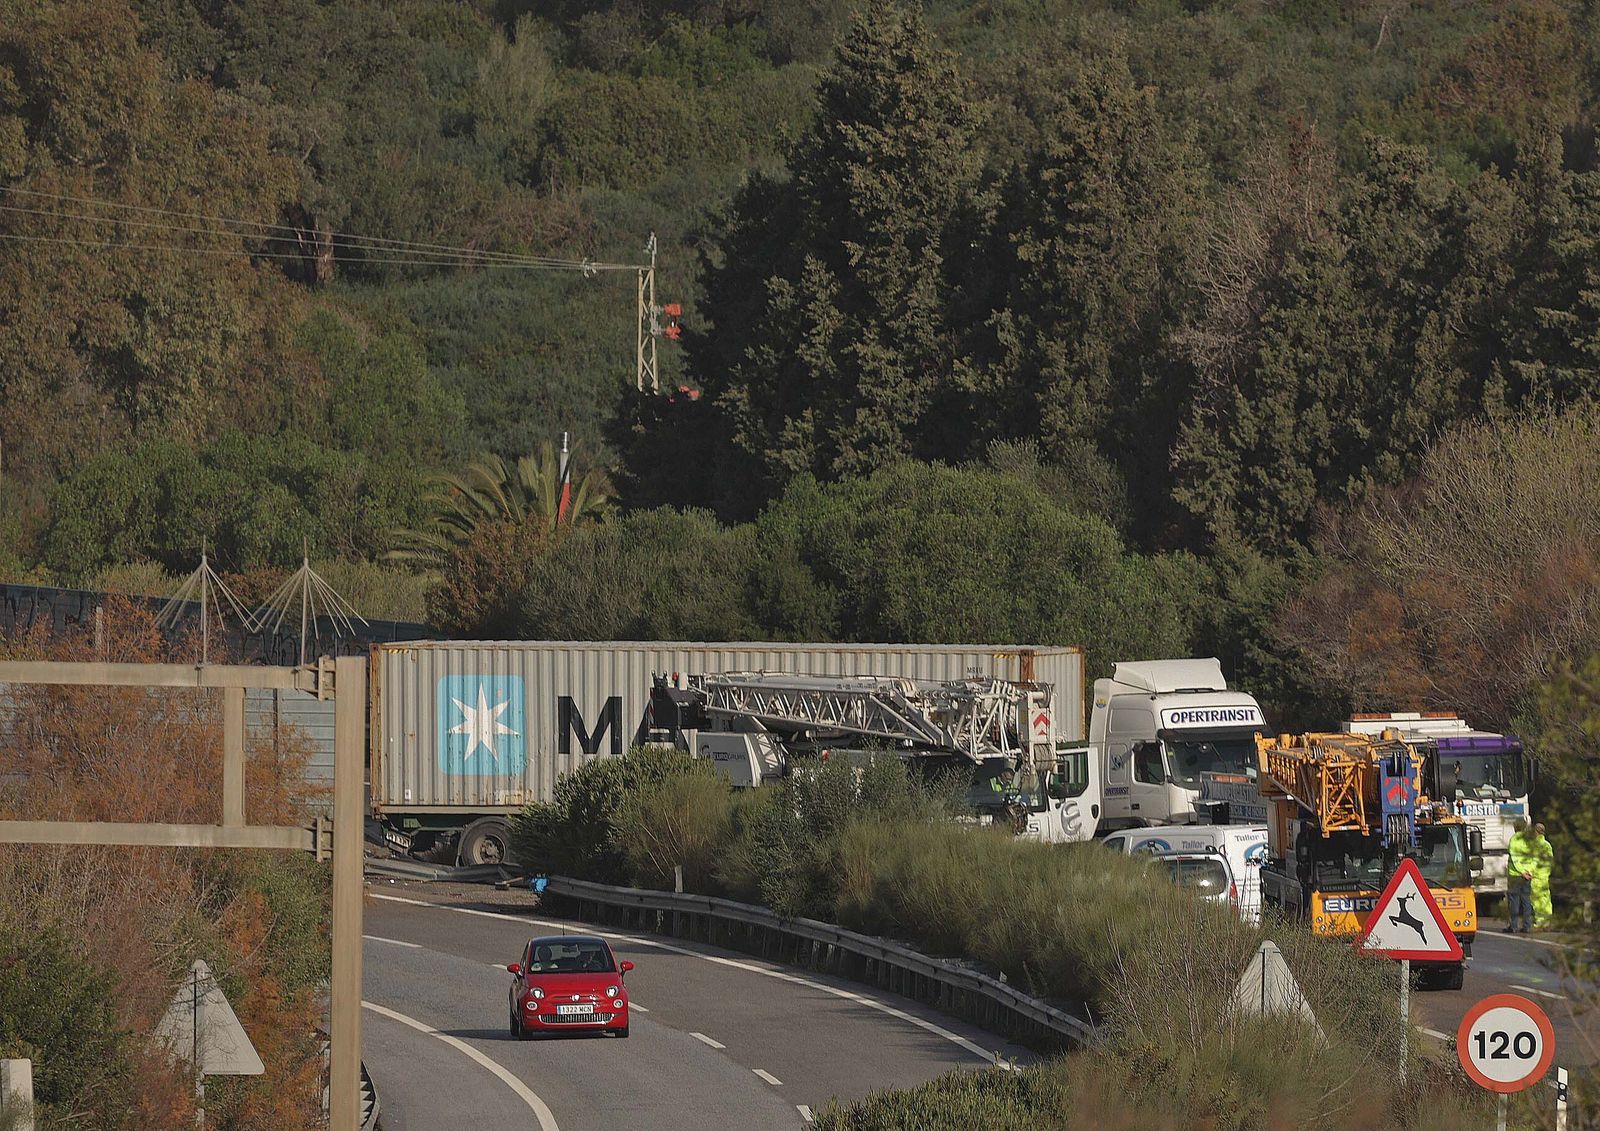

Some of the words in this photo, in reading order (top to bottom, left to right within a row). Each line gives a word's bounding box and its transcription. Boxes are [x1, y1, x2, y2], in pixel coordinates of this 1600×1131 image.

[1170, 709, 1255, 724] OPERTRANSIT
[1466, 804, 1500, 816] CASTRO
[1474, 1030, 1537, 1060] 120
